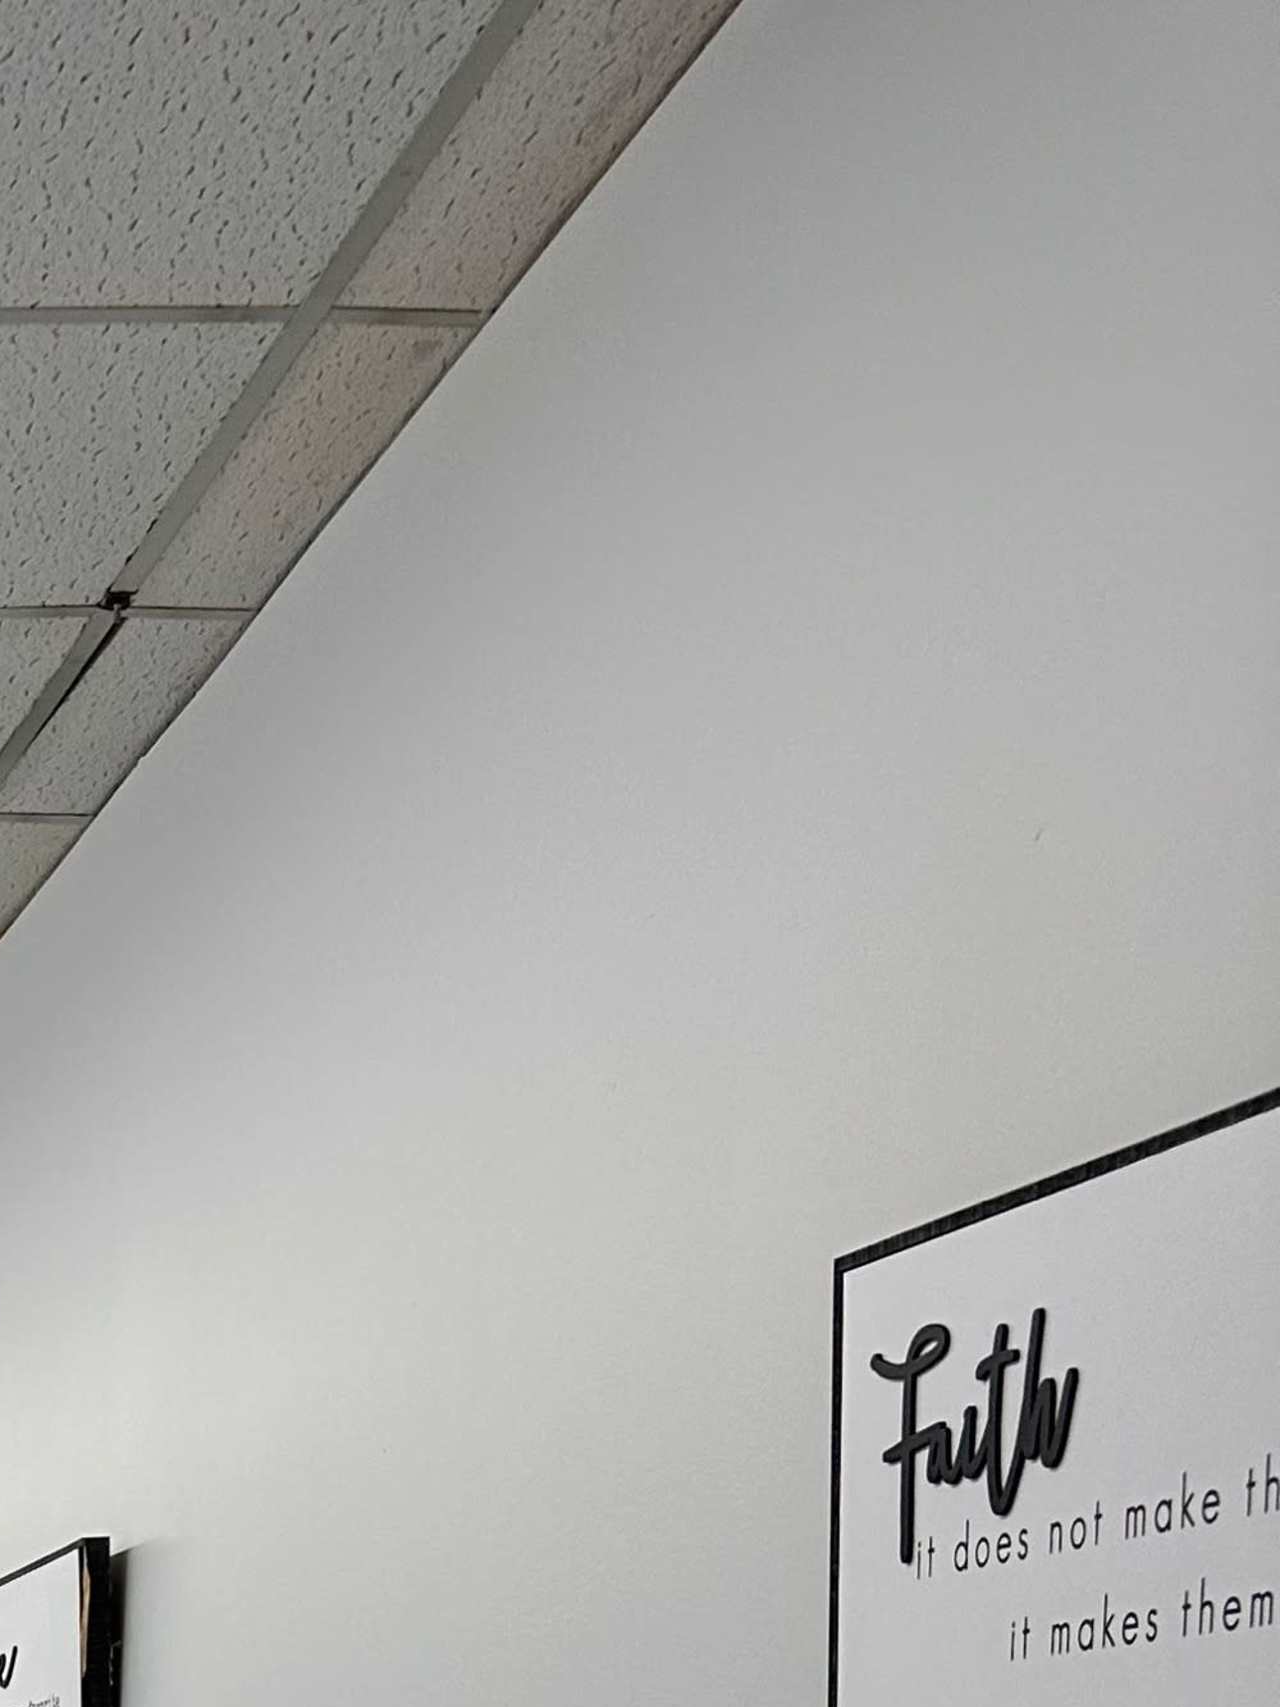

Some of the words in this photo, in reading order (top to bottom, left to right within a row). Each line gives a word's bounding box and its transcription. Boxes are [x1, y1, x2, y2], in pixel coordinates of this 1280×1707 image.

[870, 1307, 1080, 1565] Faith
[915, 1536, 935, 1580] it
[953, 1519, 1029, 1572] does
[1049, 1500, 1102, 1554] not
[1125, 1471, 1221, 1540] make
[1010, 1616, 1030, 1661] it
[1050, 1593, 1158, 1656] makes
[1182, 1577, 1274, 1637] them
